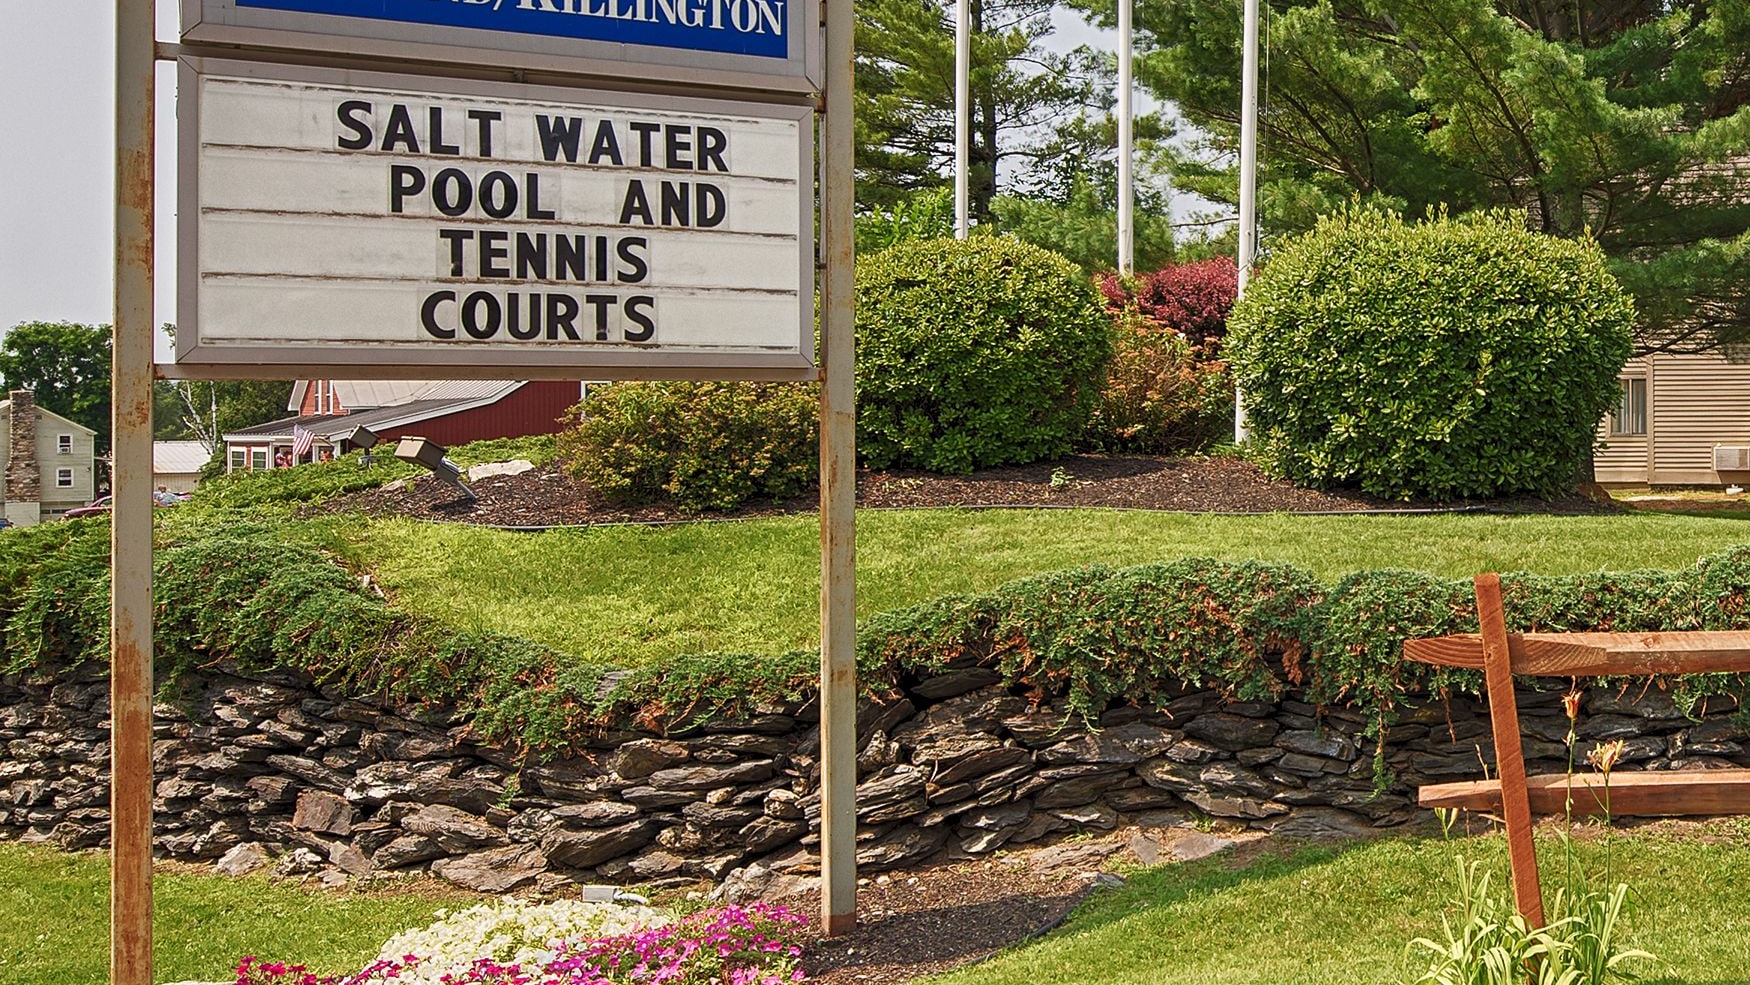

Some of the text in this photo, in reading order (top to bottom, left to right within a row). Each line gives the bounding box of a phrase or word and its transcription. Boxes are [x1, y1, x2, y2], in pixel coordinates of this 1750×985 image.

[337, 100, 729, 172] SALT WATER
[390, 165, 727, 228] POOL AND
[439, 229, 648, 283] TENNIS
[421, 291, 655, 342] COURTS
